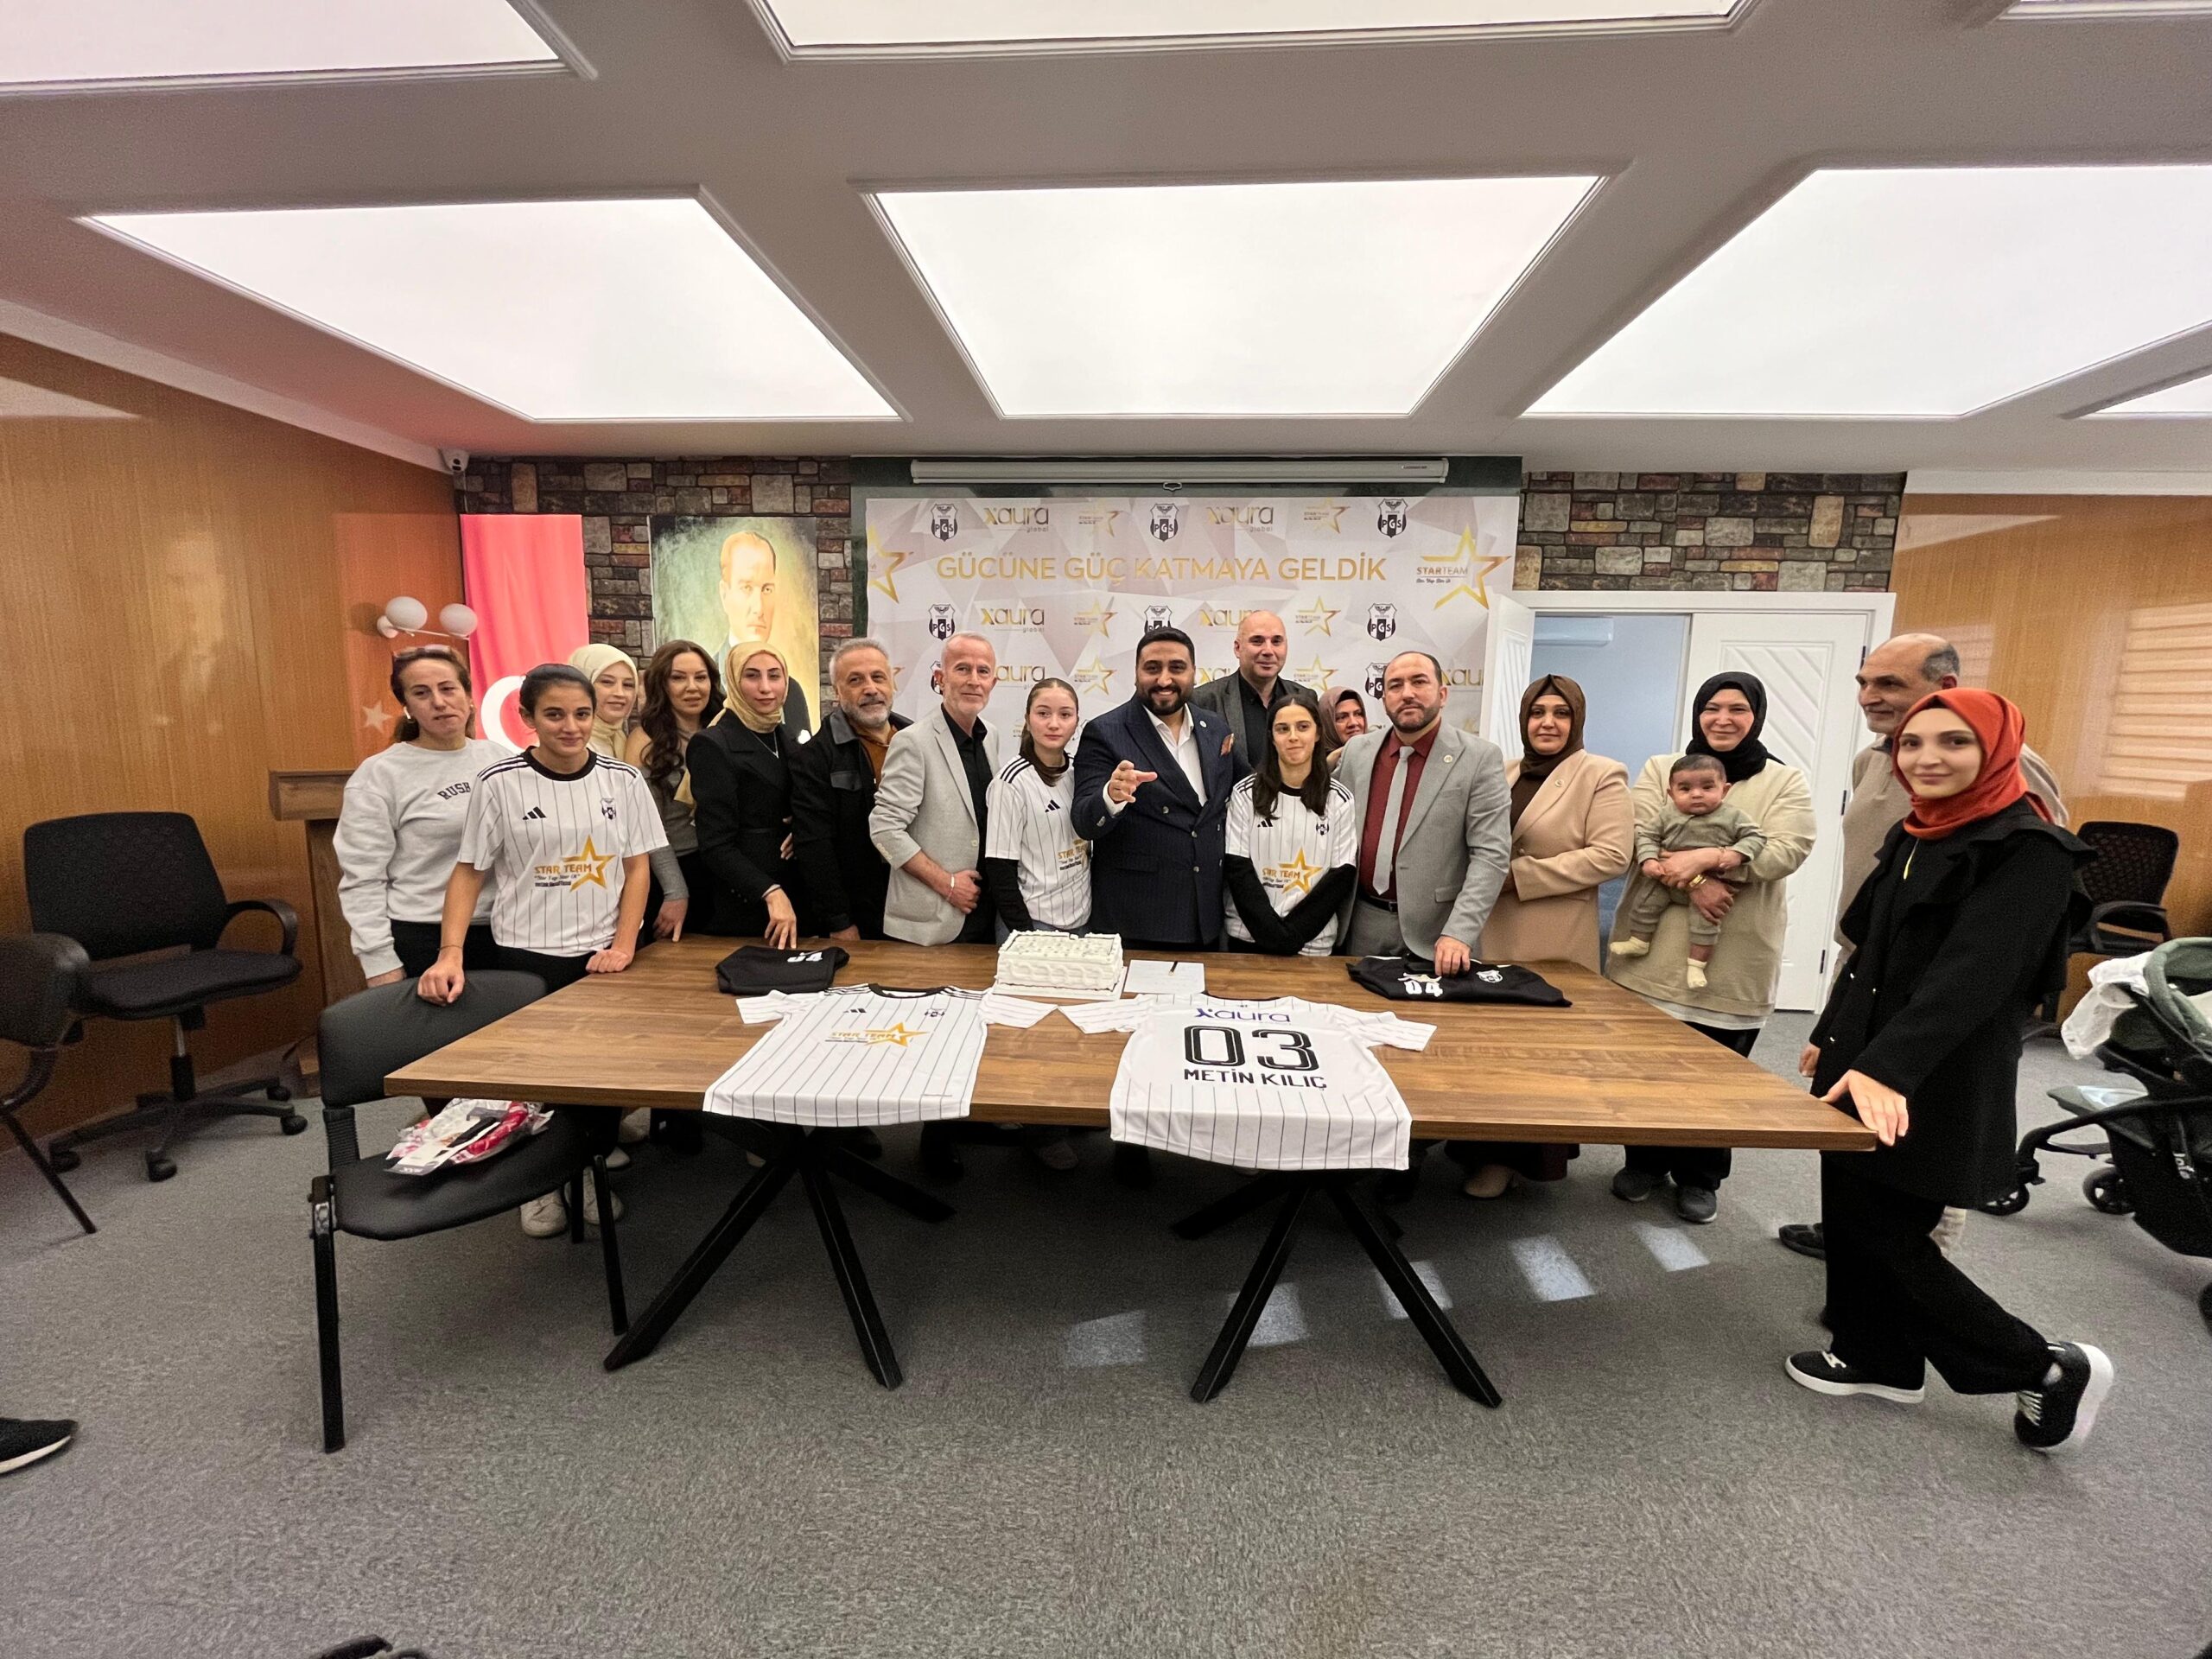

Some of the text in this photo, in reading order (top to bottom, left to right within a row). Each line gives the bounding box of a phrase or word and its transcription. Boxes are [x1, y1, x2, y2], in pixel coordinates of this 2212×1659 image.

[937, 551, 1388, 586] GÜCÜNE GÜÇ KATMAYA GELDİK
[995, 665, 1046, 683] aura
[534, 863, 592, 874] STAR TEAM
[1280, 869, 1300, 879] TEAM
[1184, 1025, 1320, 1071] 03
[1183, 1068, 1328, 1091] METİN KILIÇ
